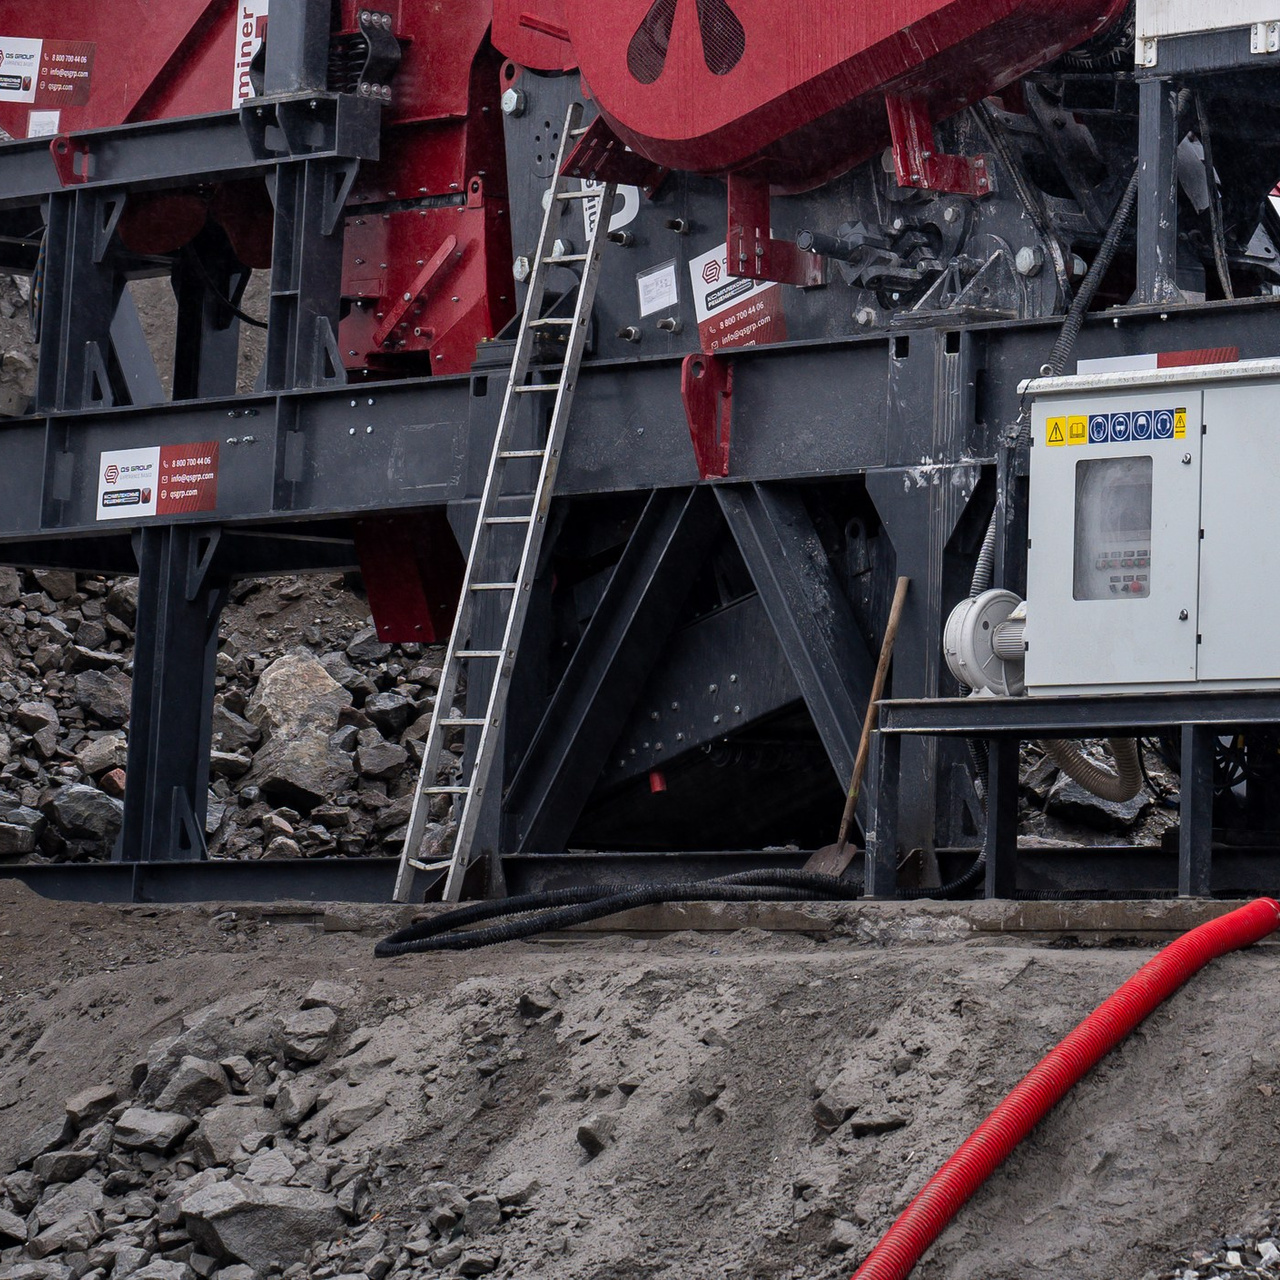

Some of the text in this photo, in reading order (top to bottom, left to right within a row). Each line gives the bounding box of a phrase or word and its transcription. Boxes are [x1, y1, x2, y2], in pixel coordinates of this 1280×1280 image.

[237, 6, 254, 99] miner
[74, 55, 80, 63] 44
[50, 68, 89, 78] info@qsgrp.com
[48, 83, 73, 91] qsgrp.com
[719, 301, 765, 329] 8 800 700 44 06
[721, 315, 771, 345] info@qsgrp.com
[172, 456, 211, 468] 8 800 700 44 06
[131, 464, 152, 472] GROUP
[171, 472, 214, 483] info@qsgrp.com
[170, 489, 197, 499] qsgrp.com
